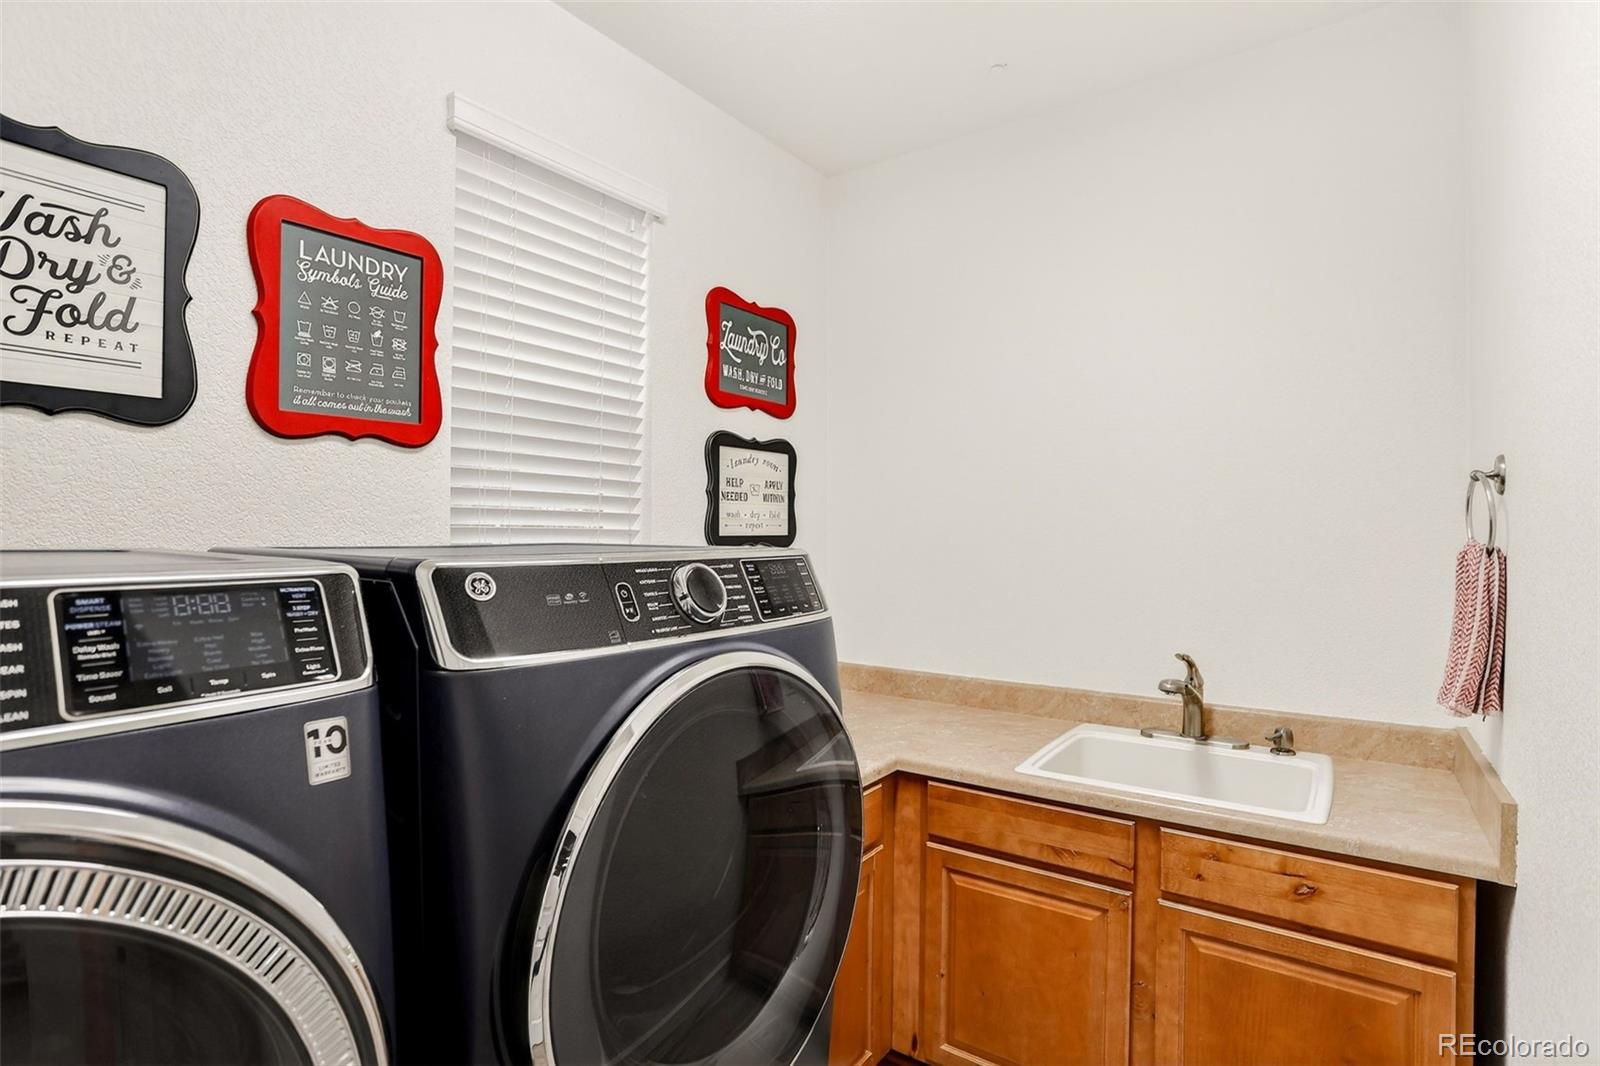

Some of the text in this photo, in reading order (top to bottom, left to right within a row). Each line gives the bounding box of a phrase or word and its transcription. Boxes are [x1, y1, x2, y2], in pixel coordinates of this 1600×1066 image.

[0, 235, 137, 294] Dry &
[299, 239, 408, 283] LAUNDRY
[296, 259, 409, 301] Symbols Guide
[3, 291, 140, 336] Fold
[45, 330, 139, 353] REPEAT
[720, 320, 787, 366] Laundry Co
[745, 369, 759, 385] DRY
[767, 375, 783, 391] FOLD
[293, 385, 335, 398] Remember
[337, 390, 345, 399] to
[302, 395, 318, 407] all
[318, 399, 347, 409] comes
[348, 402, 363, 411] out
[725, 477, 783, 491] HELP APPLY
[720, 490, 785, 504] NEEDED WITHIN
[75, 597, 105, 606] SMART
[69, 604, 112, 614] DISPENSE
[72, 645, 97, 655] Delay
[75, 672, 99, 682] Time
[208, 678, 229, 686] Temp
[261, 671, 277, 679] Spin
[88, 692, 117, 704] Sound
[307, 725, 347, 758] 10
